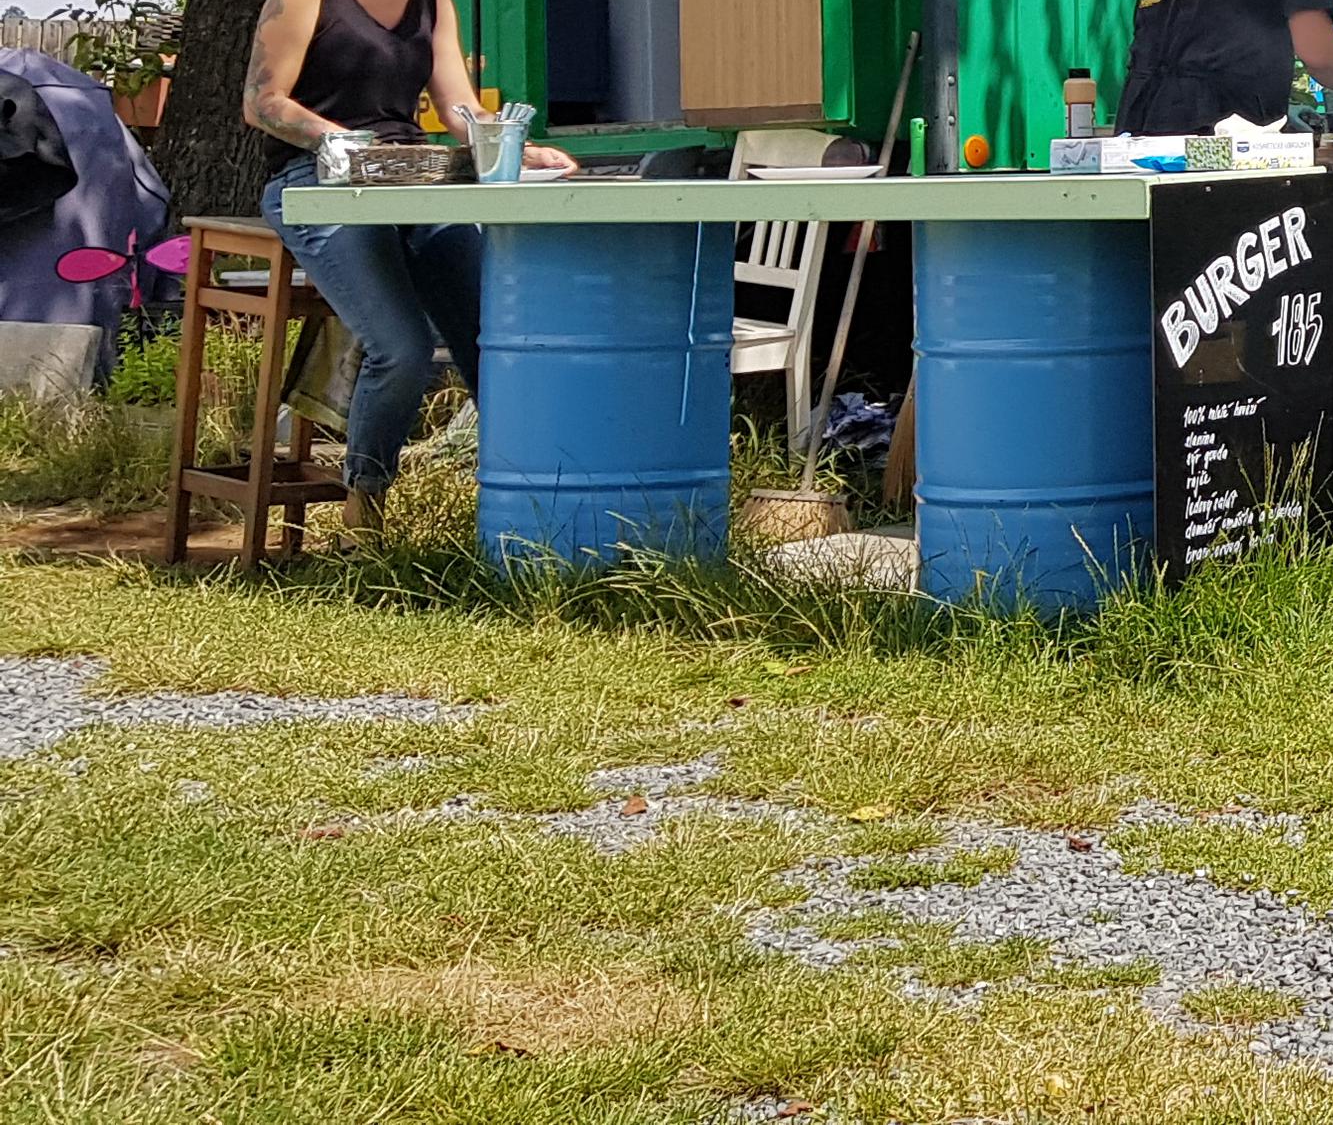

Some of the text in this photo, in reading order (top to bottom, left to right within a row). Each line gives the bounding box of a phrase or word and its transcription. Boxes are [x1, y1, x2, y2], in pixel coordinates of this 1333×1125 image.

[1160, 206, 1313, 369] BURGER
[1272, 291, 1323, 366] 185
[1184, 405, 1206, 428] 100%
